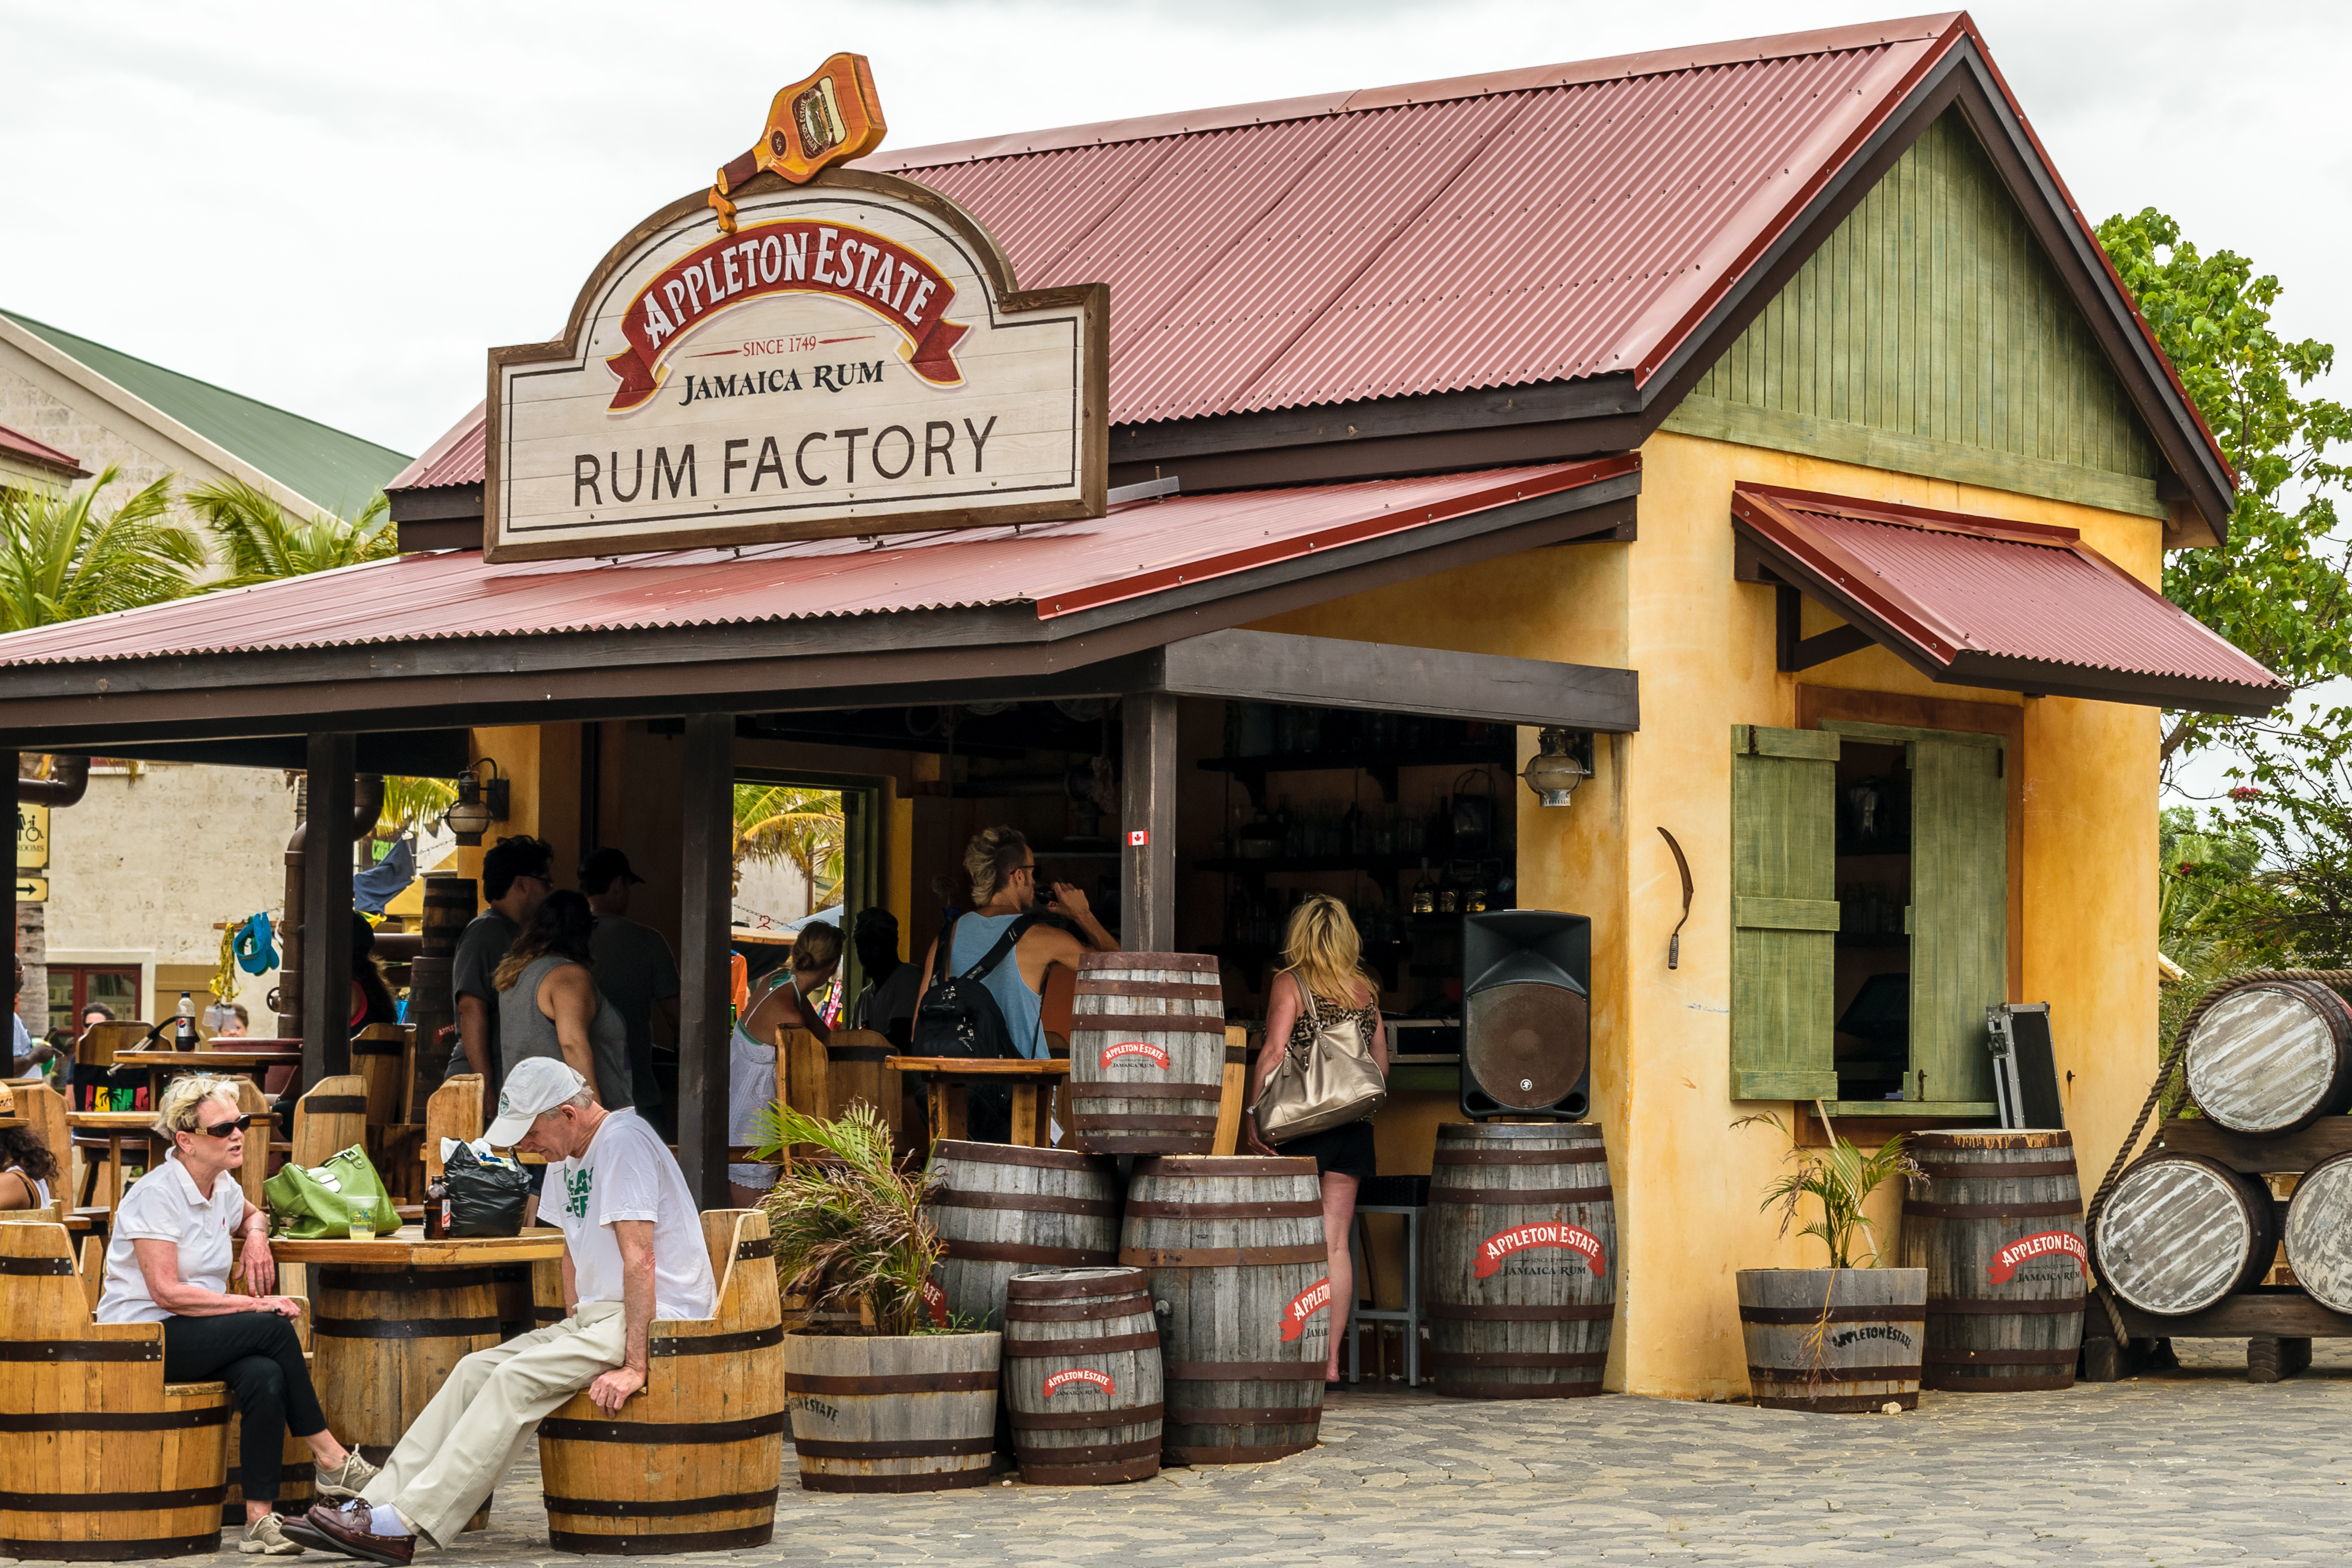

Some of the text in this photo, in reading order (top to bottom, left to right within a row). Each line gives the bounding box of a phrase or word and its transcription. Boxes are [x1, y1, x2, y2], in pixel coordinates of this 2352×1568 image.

[801, 123, 819, 151] APPLETON
[644, 227, 936, 350] APPLETON ESTATE
[743, 336, 816, 357] SINCE 1749
[678, 360, 885, 407] JAMAICA RUM
[574, 415, 998, 507] RUM FACTORY
[1105, 1044, 1164, 1060] APPLETON ESTATE
[1487, 1226, 1600, 1259] APPLETON ESTATE
[2002, 1234, 2085, 1267] APPLETON ESTATE
[1502, 1266, 1586, 1276] JAMAICA RUM
[2016, 1271, 2080, 1283] JAMAICA RUM
[1886, 1326, 1912, 1350] ESTATE
[1048, 1370, 1109, 1388] APPLETON ESTATE
[804, 1396, 839, 1423] ESTATE
